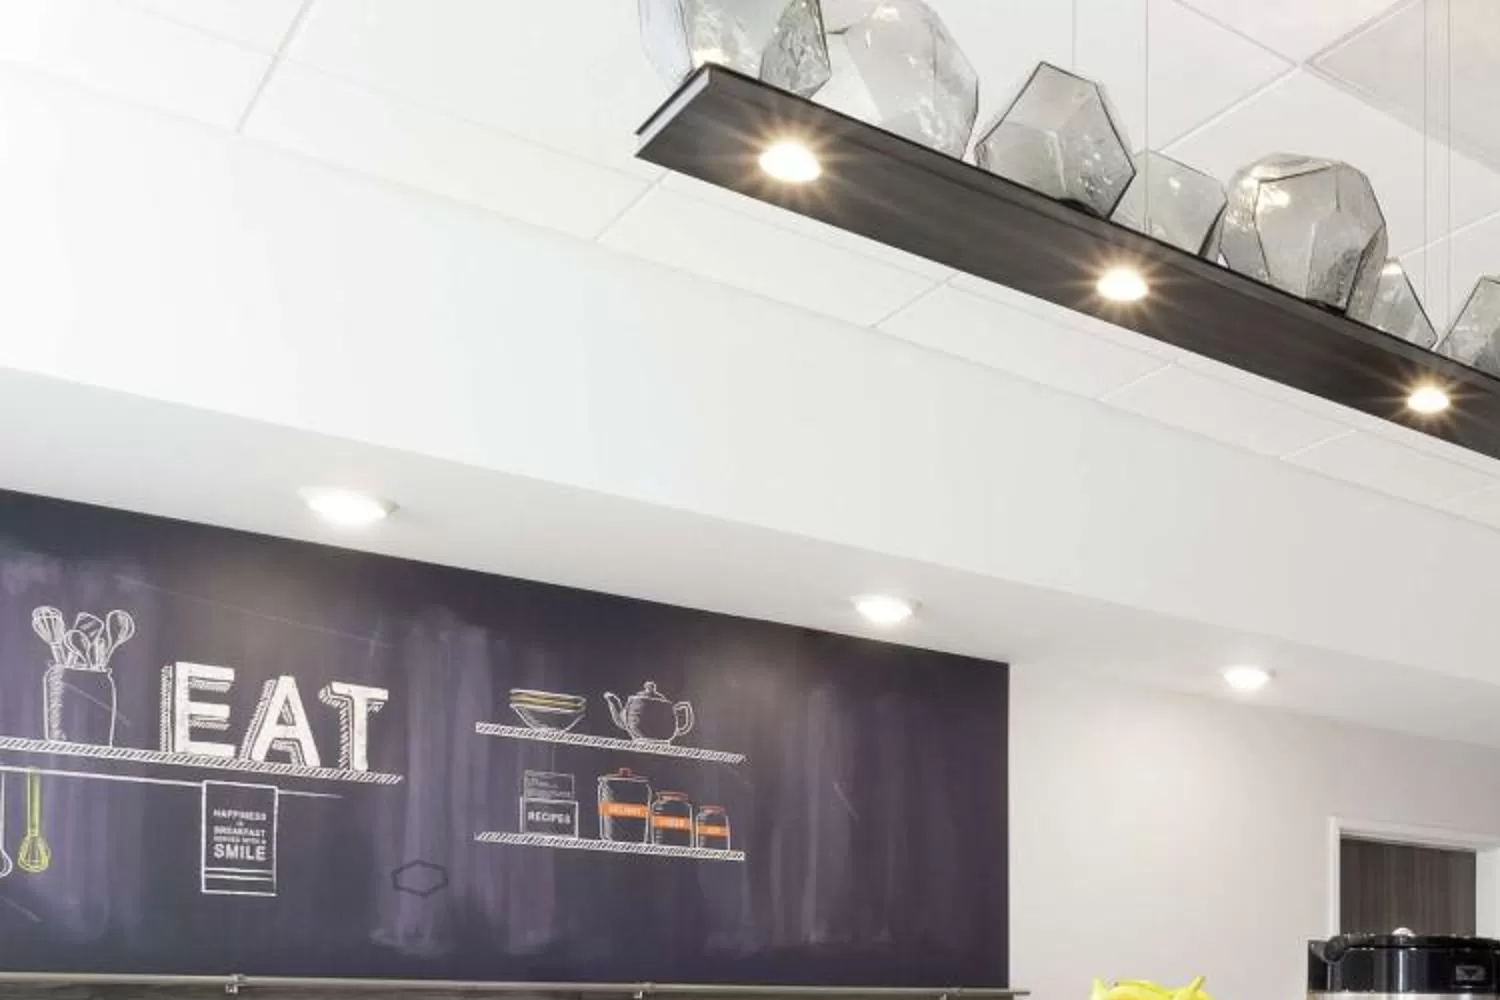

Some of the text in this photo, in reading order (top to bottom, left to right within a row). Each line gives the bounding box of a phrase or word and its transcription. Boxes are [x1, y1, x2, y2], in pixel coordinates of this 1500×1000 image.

[160, 661, 389, 772] EAT
[527, 811, 571, 825] RECIPES
[213, 844, 266, 861] SMILE
